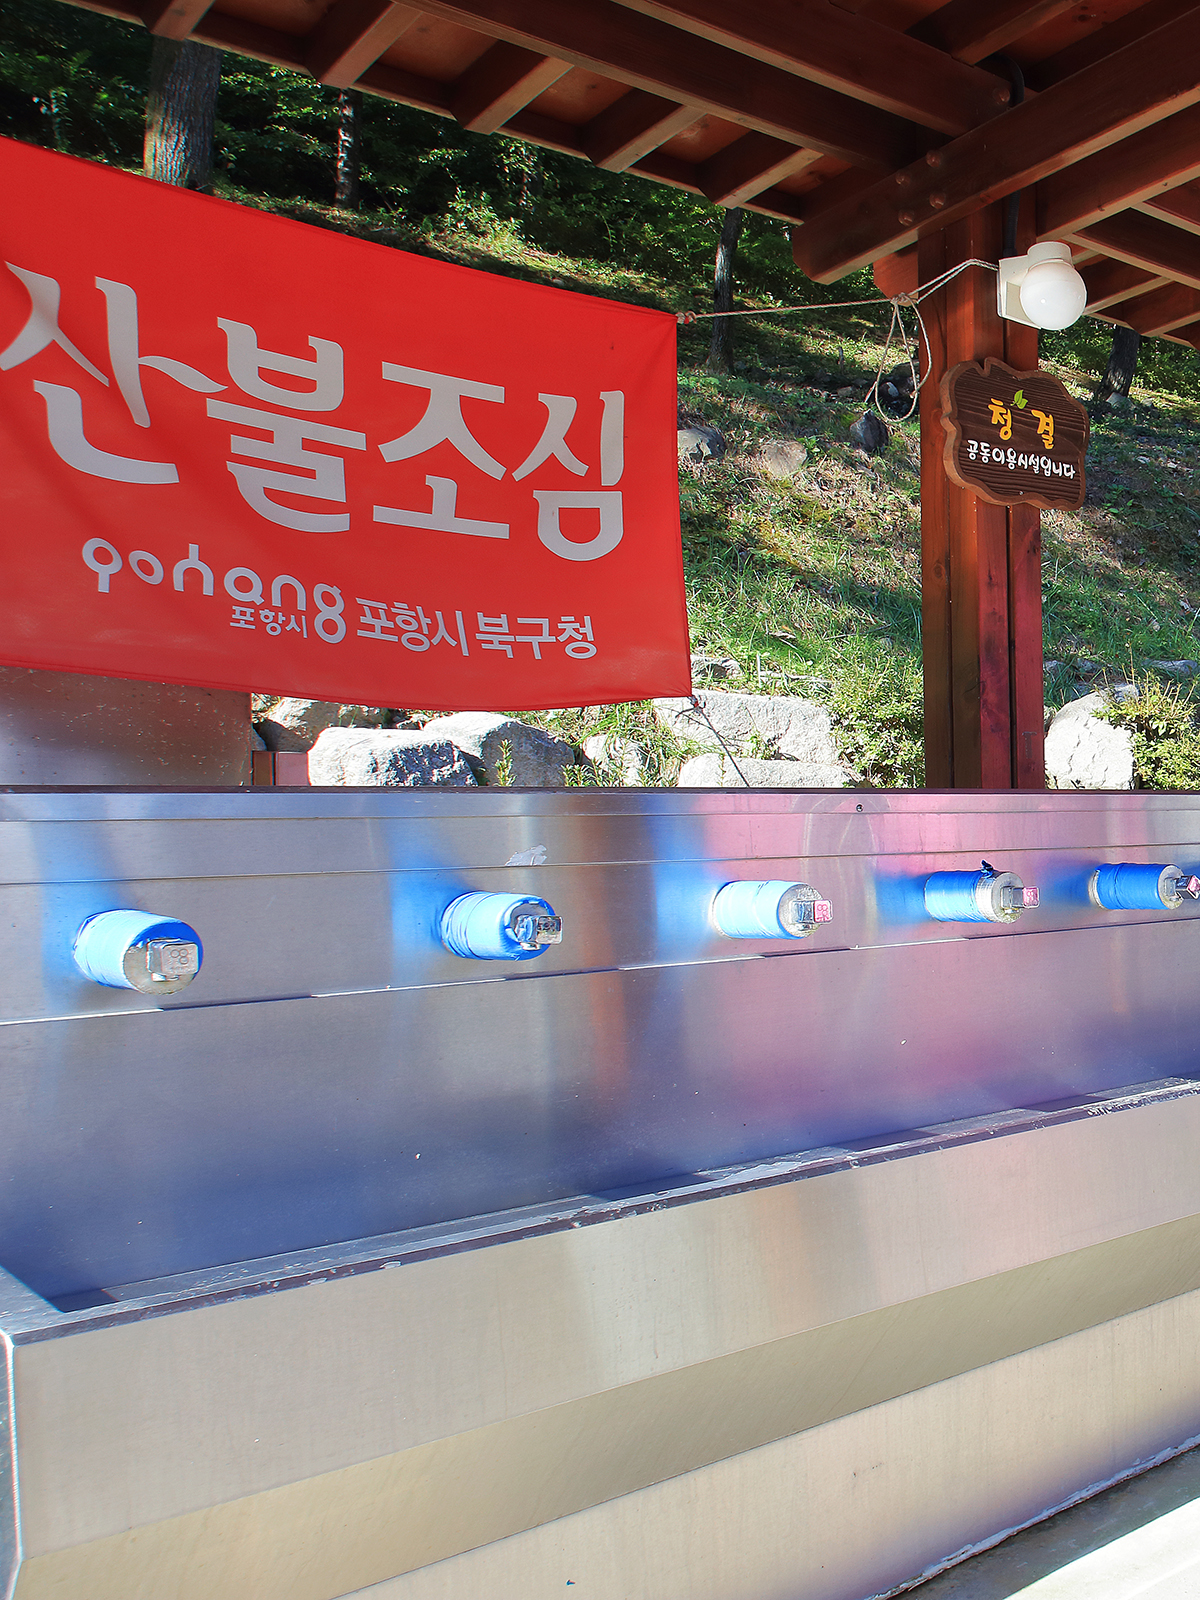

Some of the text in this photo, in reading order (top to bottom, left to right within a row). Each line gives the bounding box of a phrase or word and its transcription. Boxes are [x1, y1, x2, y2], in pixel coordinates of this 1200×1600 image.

[0, 260, 625, 562] 산불조심
[987, 397, 1013, 441] 청
[966, 439, 1076, 480] 공동이용시설입니다
[229, 605, 308, 639] 포항시
[355, 597, 598, 660] 포항시 북구청
